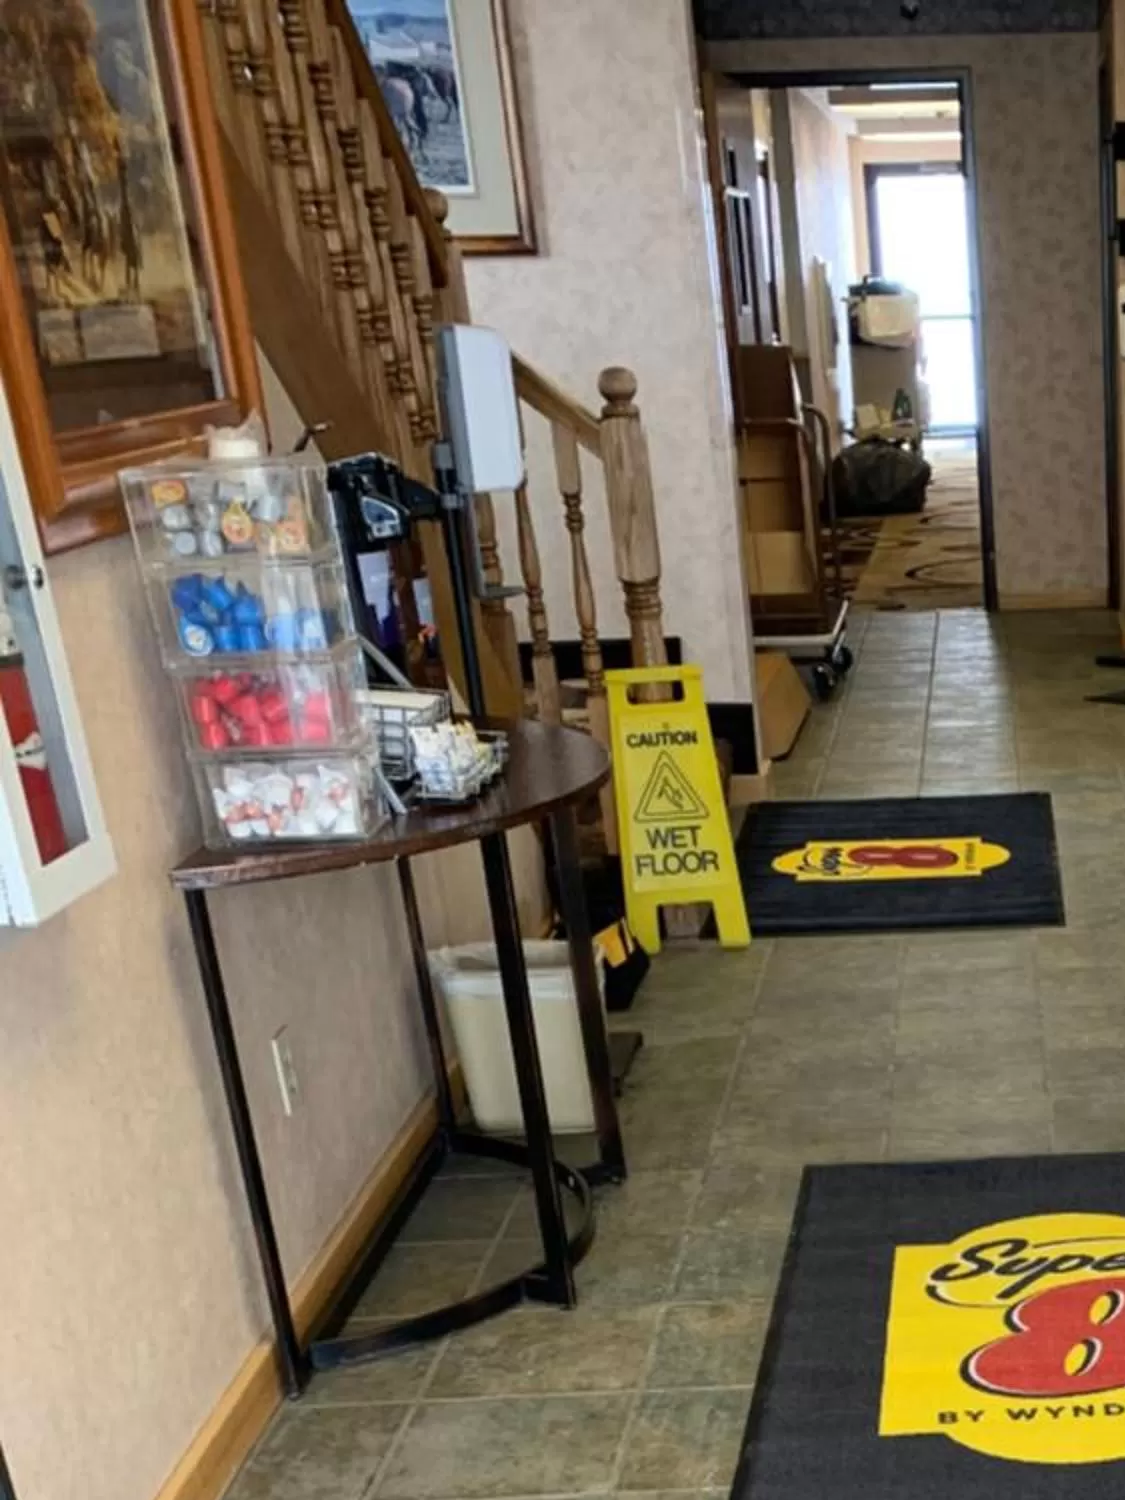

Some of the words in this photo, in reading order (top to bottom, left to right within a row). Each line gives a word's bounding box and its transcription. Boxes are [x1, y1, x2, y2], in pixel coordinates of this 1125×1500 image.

[627, 730, 698, 748] CAUTION
[645, 825, 702, 849] WET
[634, 850, 720, 877] FLOOR
[938, 1409, 985, 1425] BY
